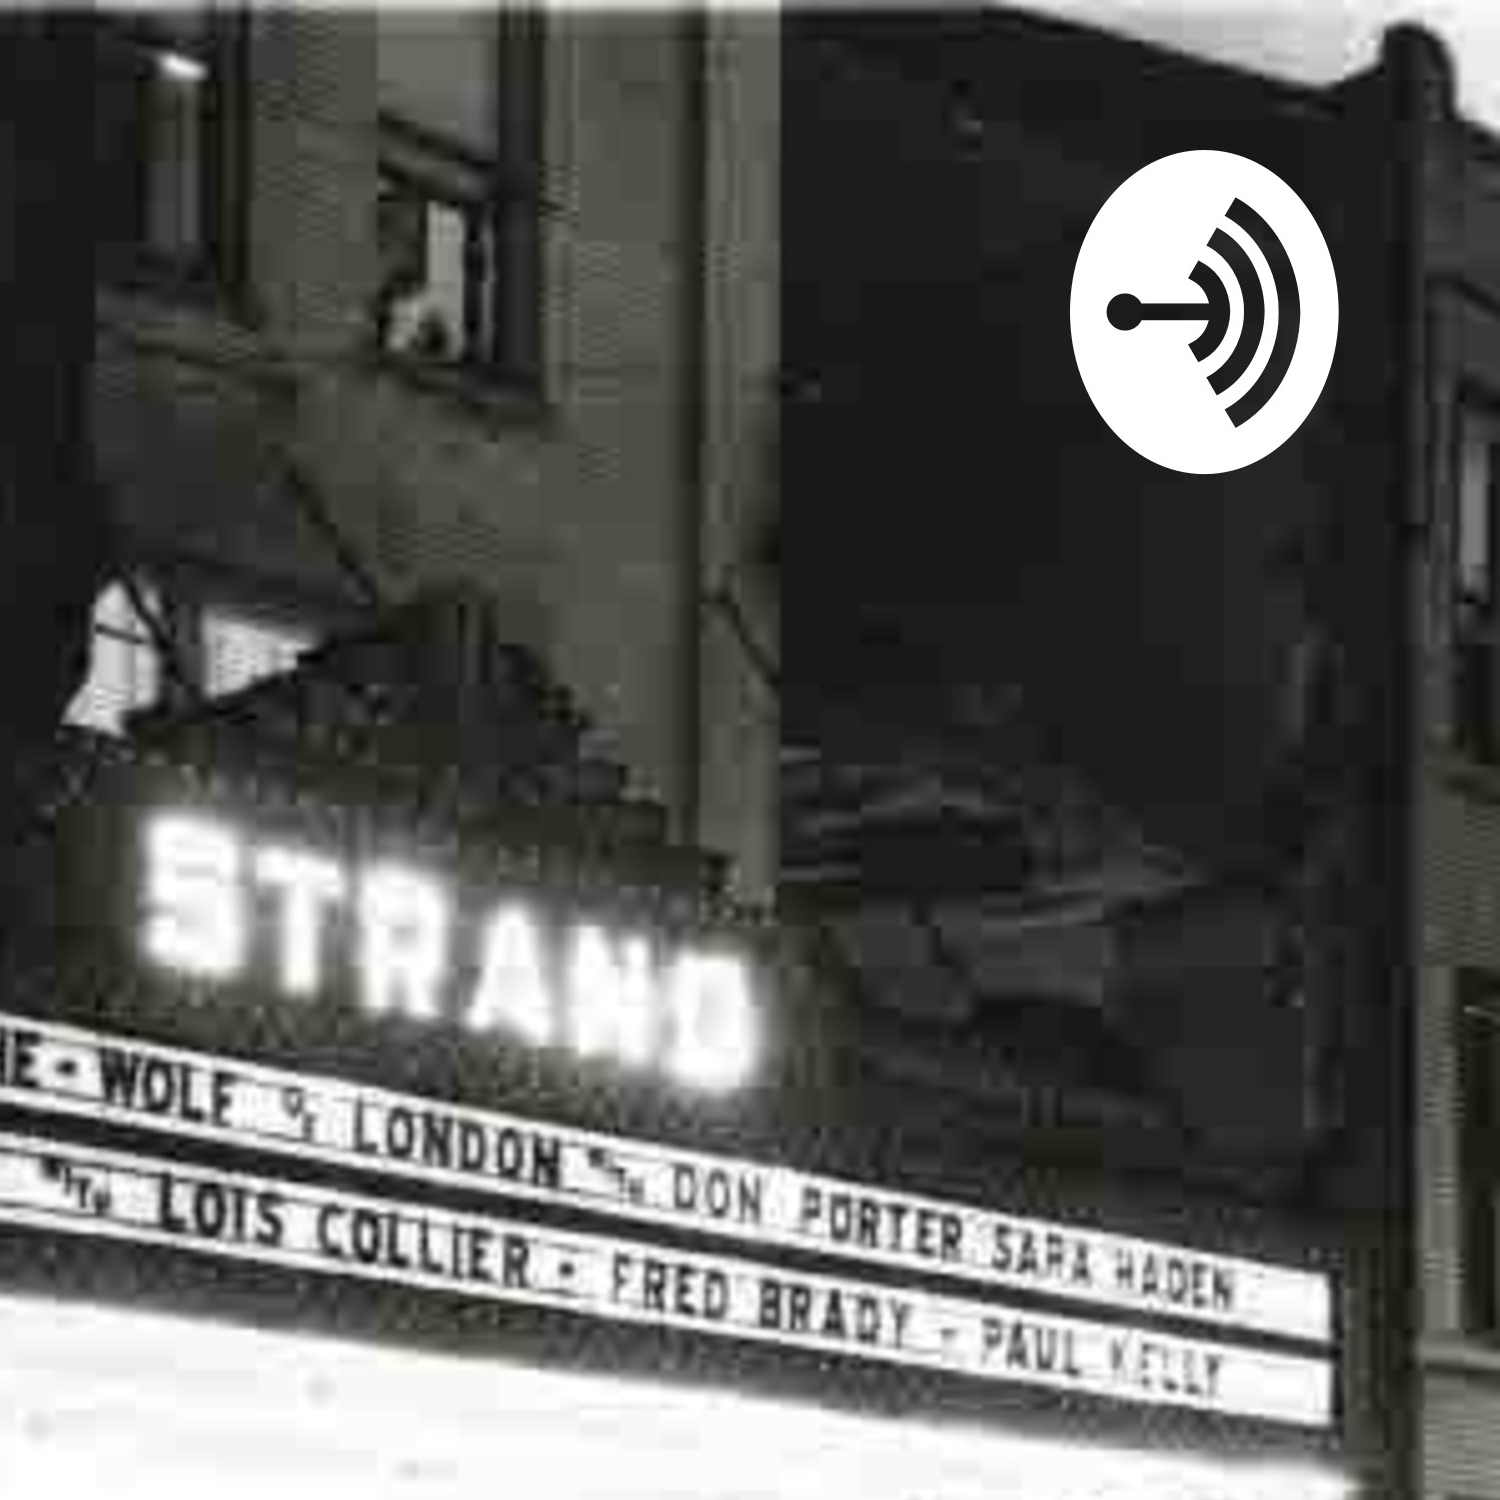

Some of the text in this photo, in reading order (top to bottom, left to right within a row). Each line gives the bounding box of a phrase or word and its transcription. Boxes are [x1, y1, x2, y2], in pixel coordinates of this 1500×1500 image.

[145, 812, 760, 1092] STRAND
[159, 1172, 283, 1245] LOIS
[316, 1205, 530, 1288] COLLIER
[612, 1253, 729, 1319] FRED
[759, 1279, 912, 1348] BRADY
[981, 1317, 1082, 1380] PAUL
[351, 1096, 561, 1188] LONDON
[674, 1161, 762, 1224] DON
[801, 1186, 963, 1262] PORTER
[1116, 1248, 1235, 1312] HADEN
